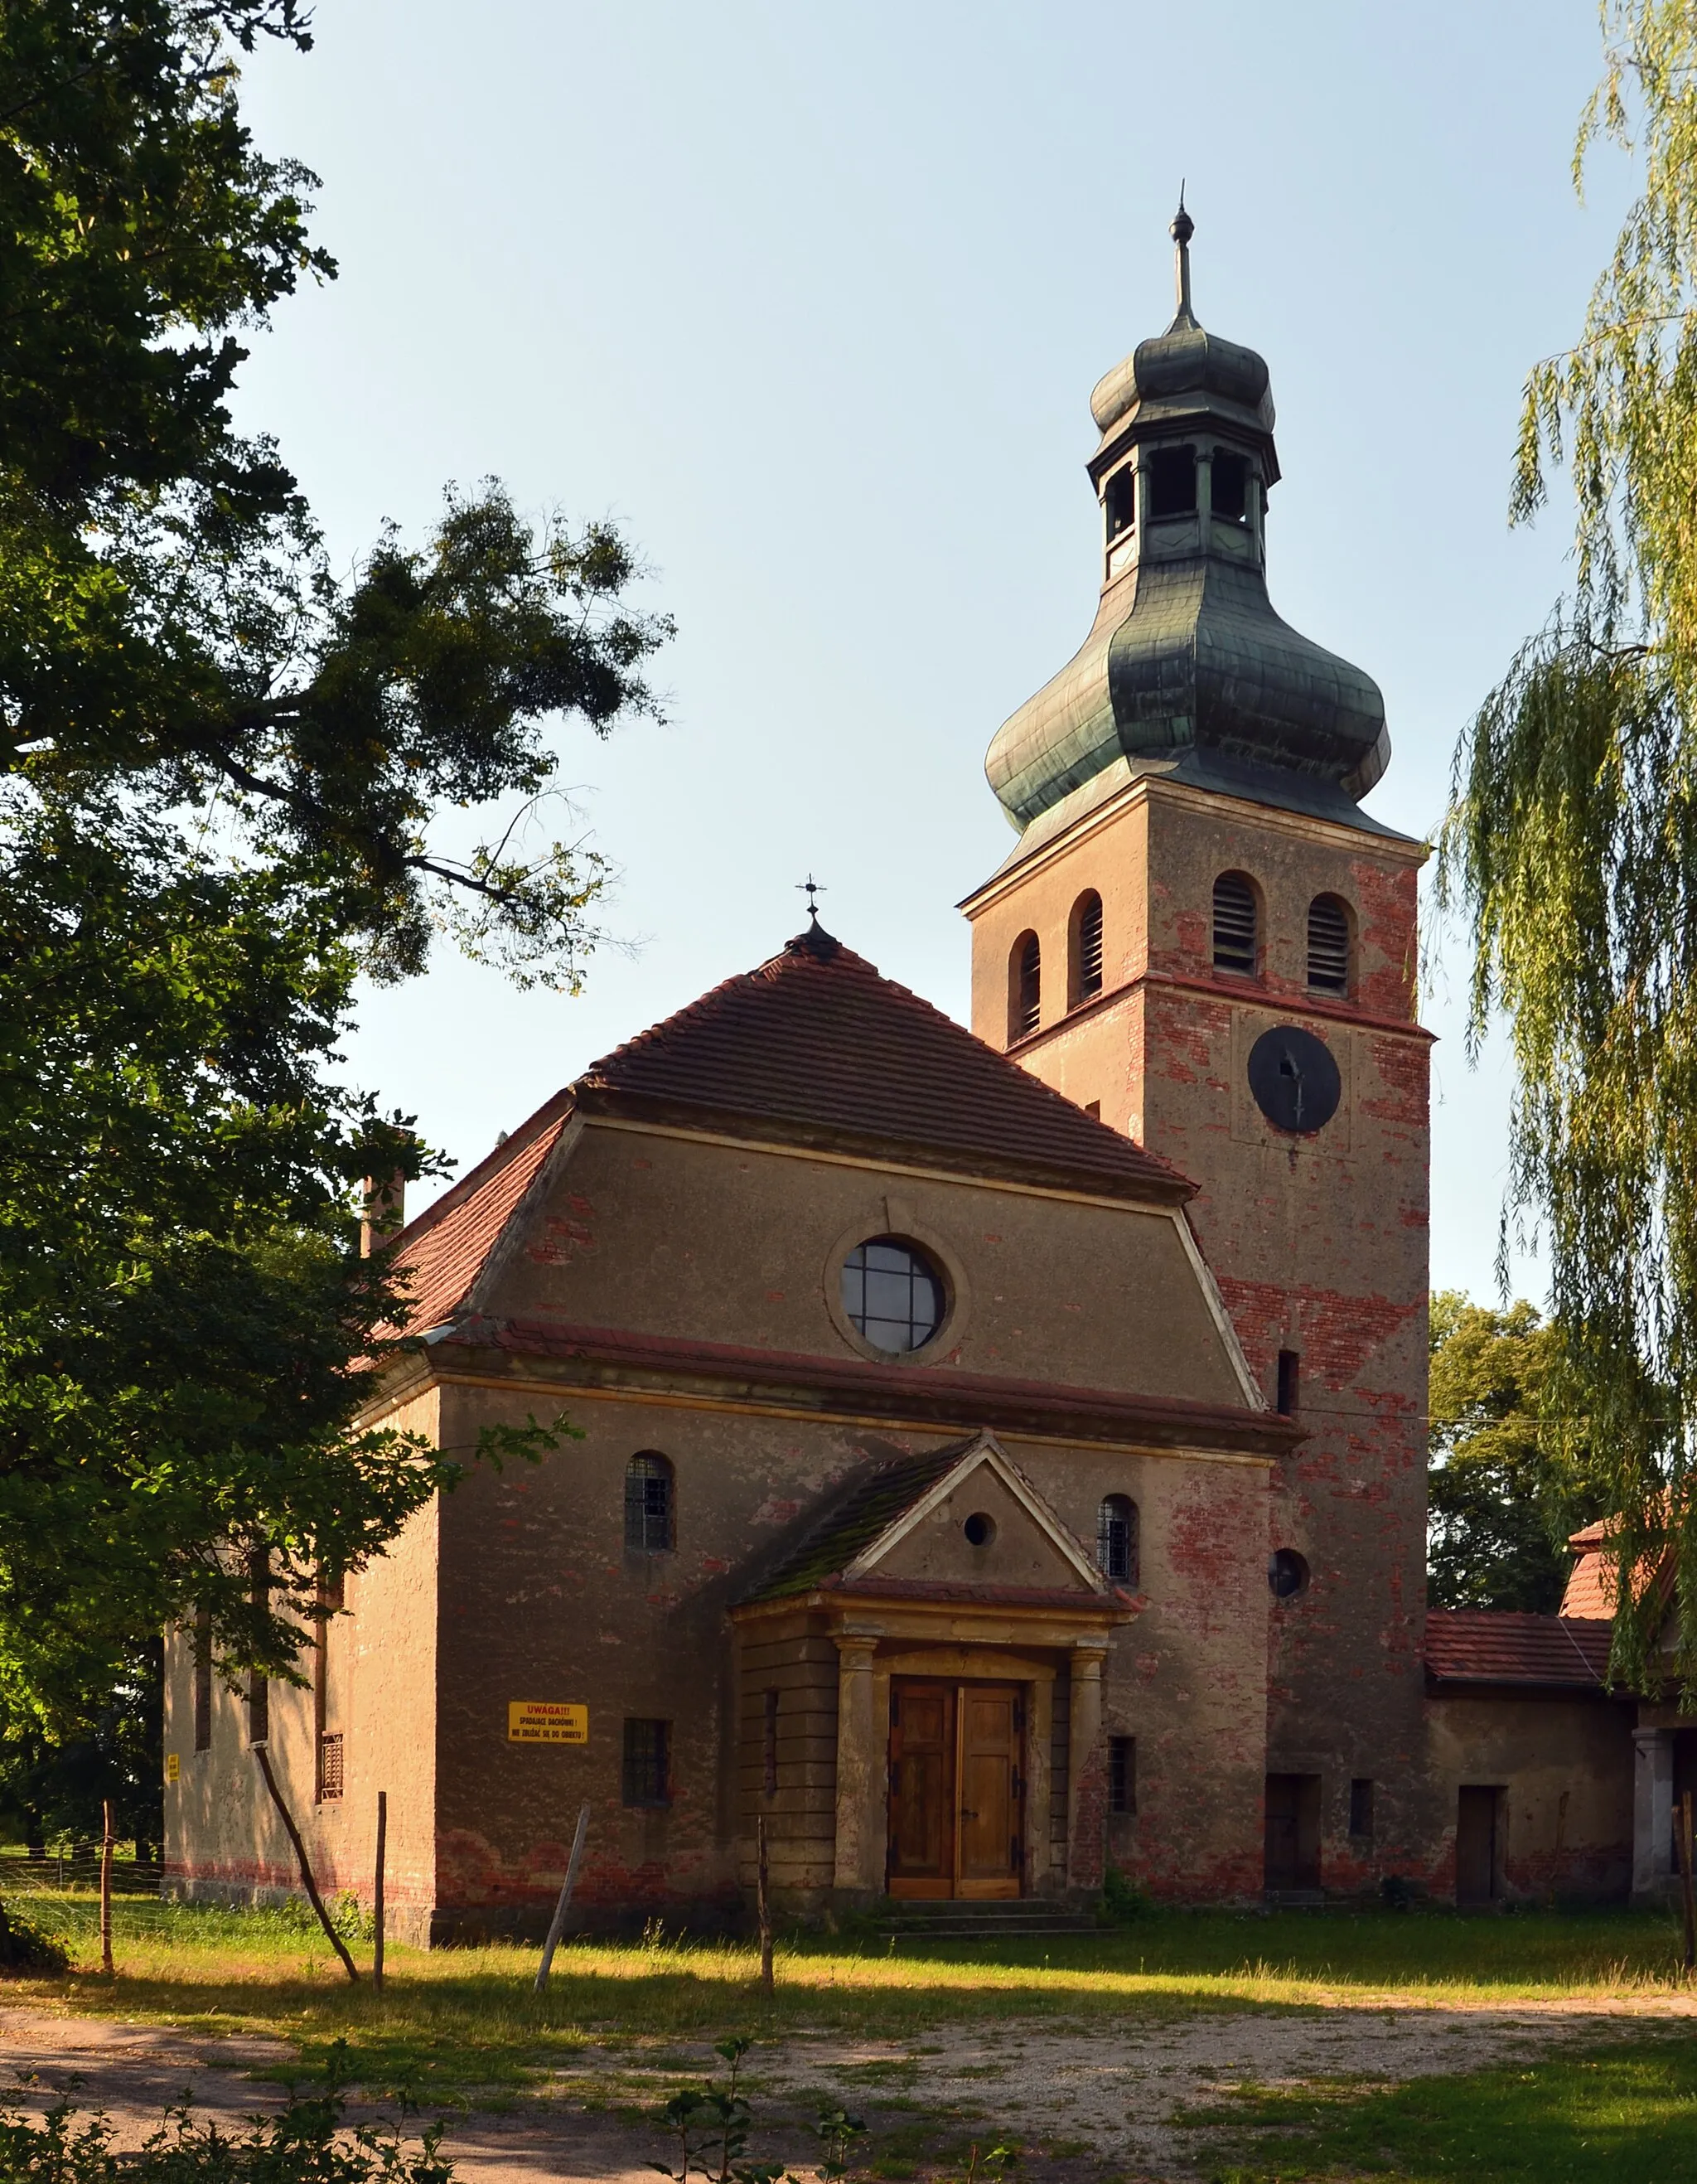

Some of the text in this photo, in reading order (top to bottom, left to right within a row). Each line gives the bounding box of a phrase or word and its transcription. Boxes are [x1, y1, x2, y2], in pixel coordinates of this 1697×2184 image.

[527, 1705, 570, 1716] UWAGA!!!
[511, 1728, 520, 1737] NIE
[551, 1730, 559, 1738] DO
